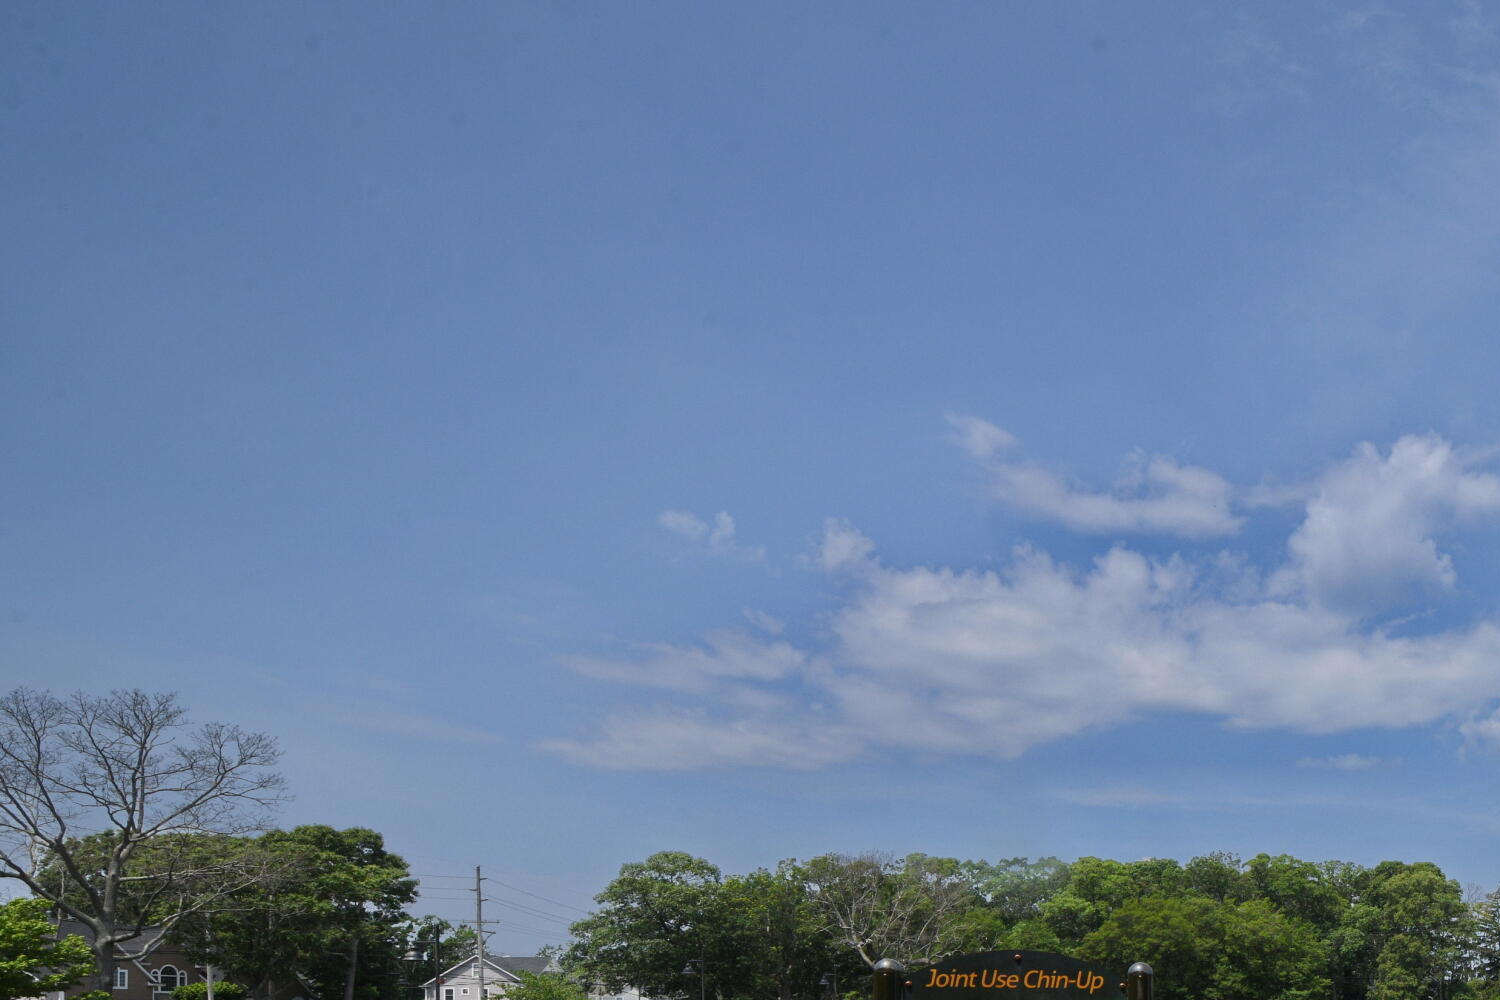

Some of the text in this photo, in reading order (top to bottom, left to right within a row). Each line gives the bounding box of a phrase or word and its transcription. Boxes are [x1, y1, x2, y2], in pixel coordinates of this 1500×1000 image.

[925, 968, 1104, 995] Joint Use Chin-Up
